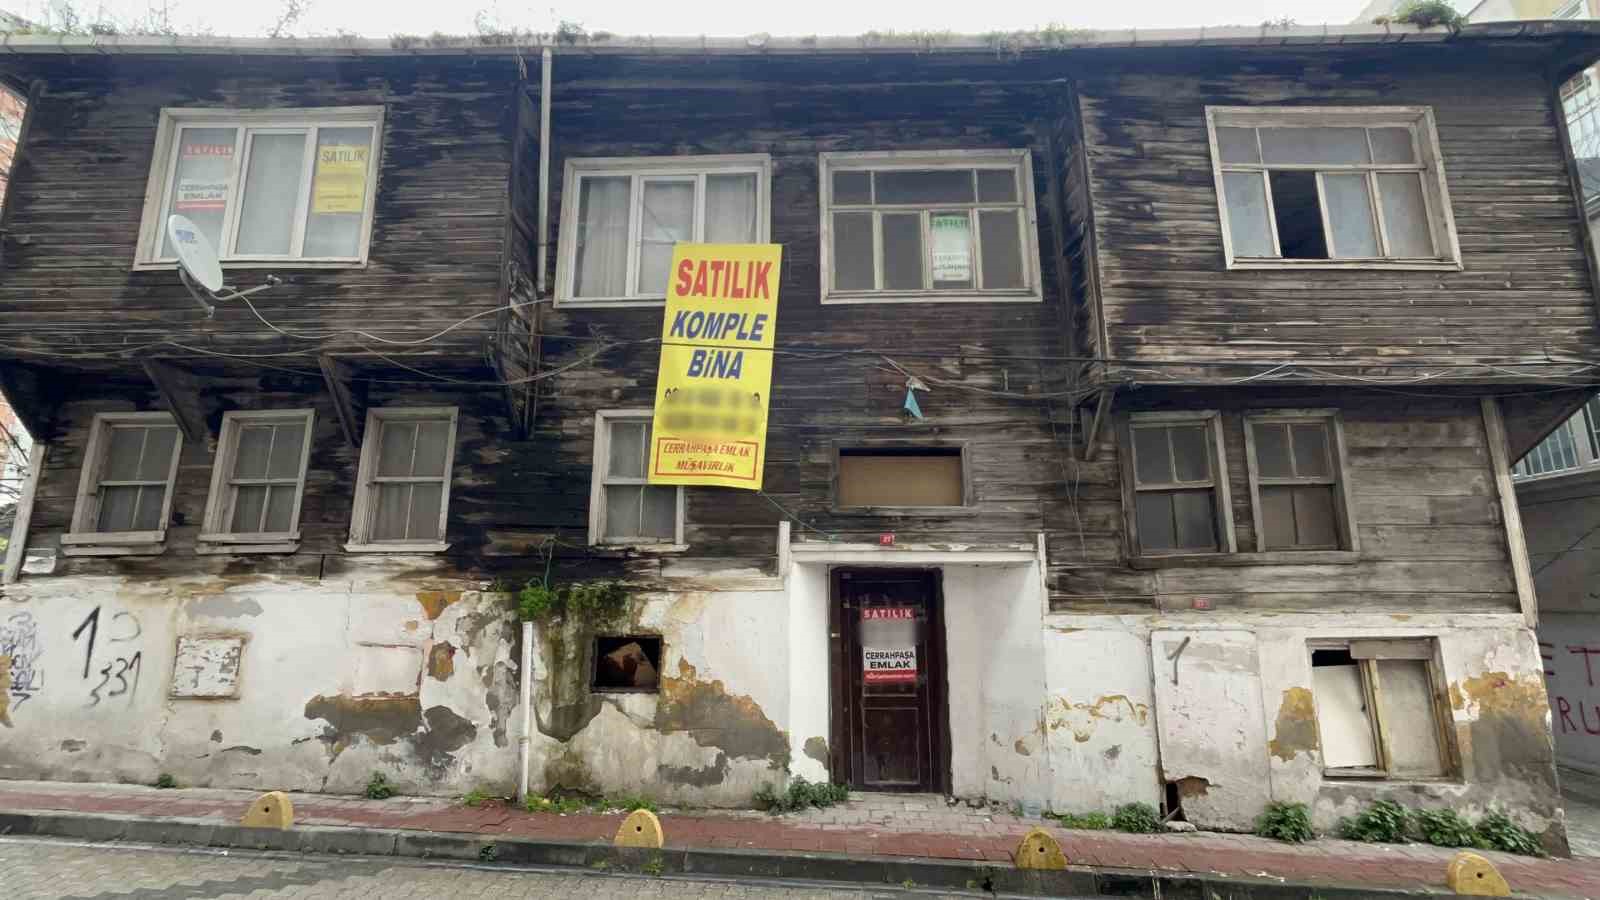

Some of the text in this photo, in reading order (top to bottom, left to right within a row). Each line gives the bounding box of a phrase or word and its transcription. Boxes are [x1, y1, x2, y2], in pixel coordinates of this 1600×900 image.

[322, 150, 367, 162] SATILIK
[675, 258, 773, 299] SATILIK
[669, 310, 768, 342] KOMPLE
[719, 443, 751, 457] EMLAK
[863, 608, 913, 619] SATILIK
[870, 660, 911, 669] EMLAK
